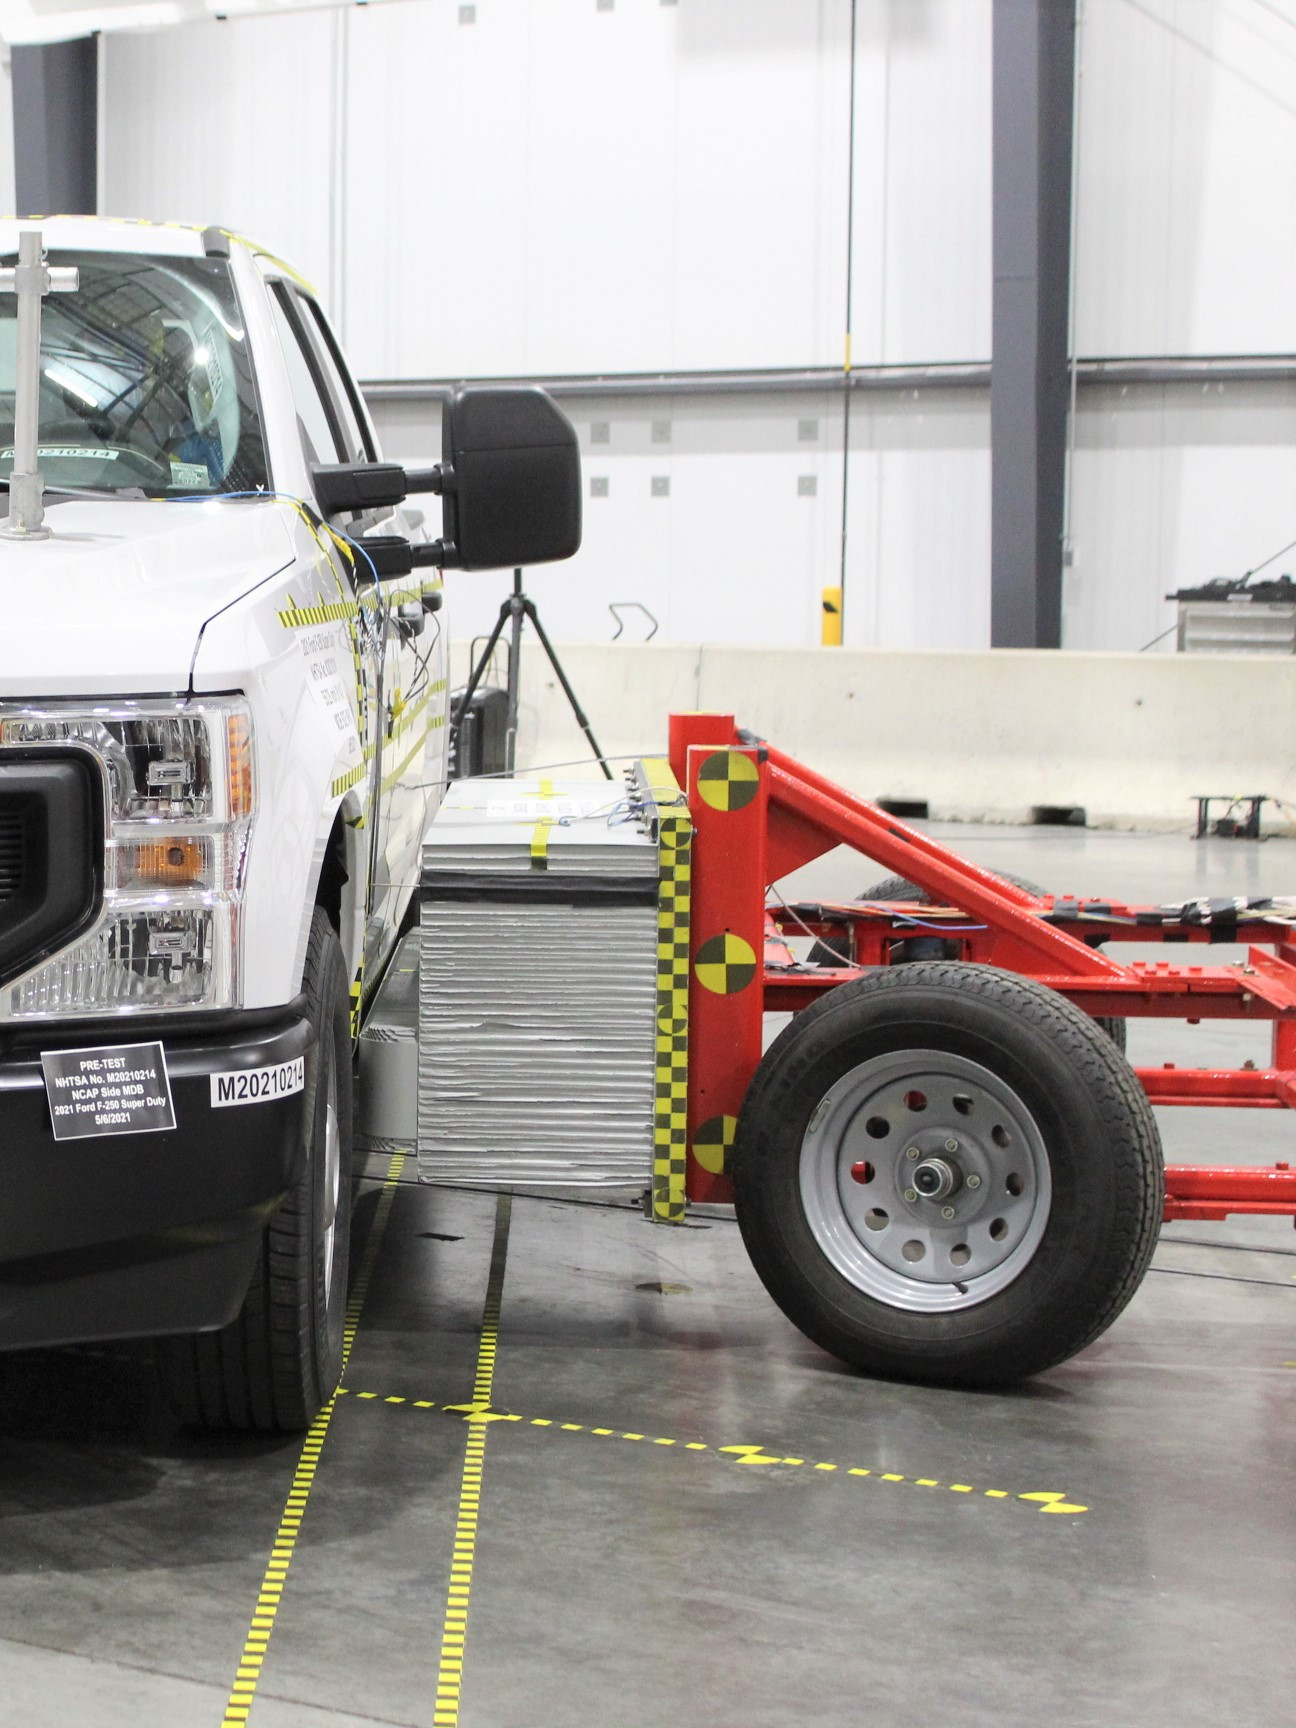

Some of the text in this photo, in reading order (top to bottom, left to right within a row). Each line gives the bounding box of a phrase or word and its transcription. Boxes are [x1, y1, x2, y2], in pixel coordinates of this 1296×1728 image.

[79, 1057, 126, 1071] PRE-TEST
[55, 1069, 156, 1088] NHTSA No. M20210214
[217, 1061, 303, 1102] M20210214
[71, 1084, 144, 1100] NCAP Side MDB
[54, 1096, 166, 1115] 2021 Ford F-250 Super Duty
[94, 1112, 131, 1125] 5/6/2021
